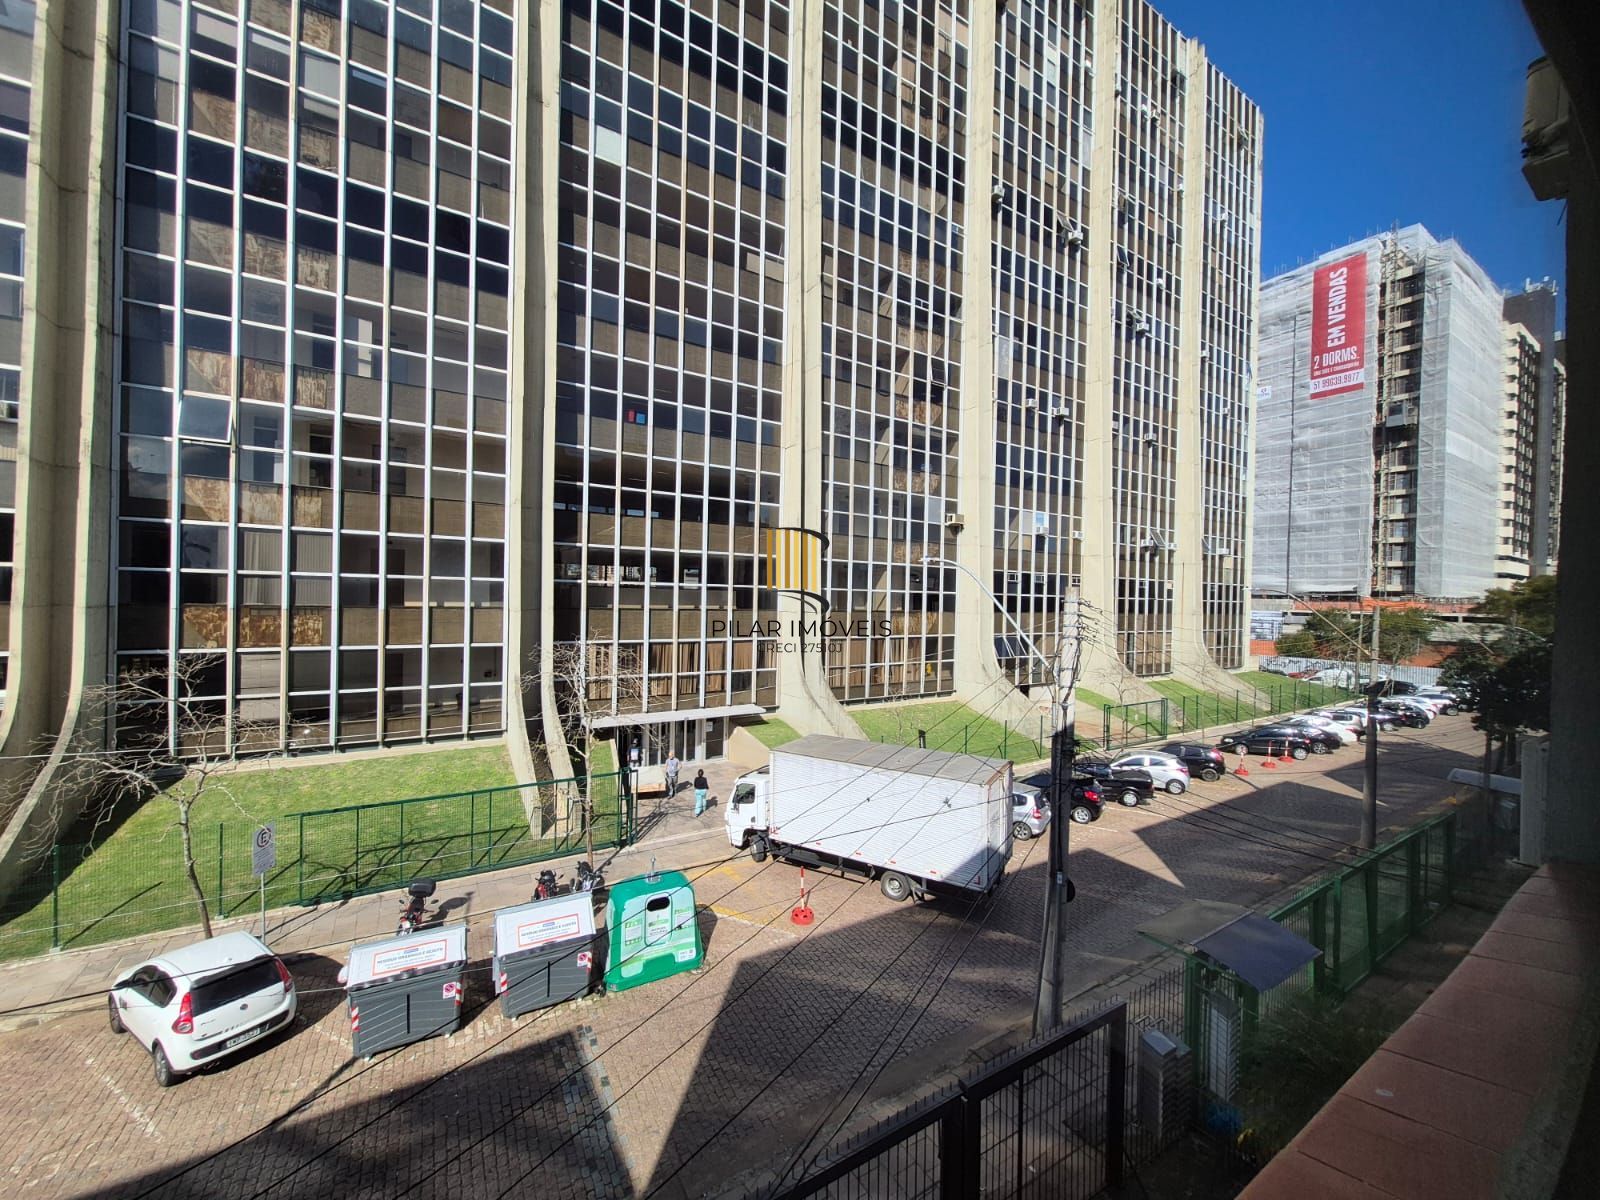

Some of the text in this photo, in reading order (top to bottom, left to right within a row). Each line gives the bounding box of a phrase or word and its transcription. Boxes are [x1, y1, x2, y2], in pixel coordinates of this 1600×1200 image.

[1328, 267, 1347, 347] EM VENDAS
[1314, 355, 1320, 370] 2
